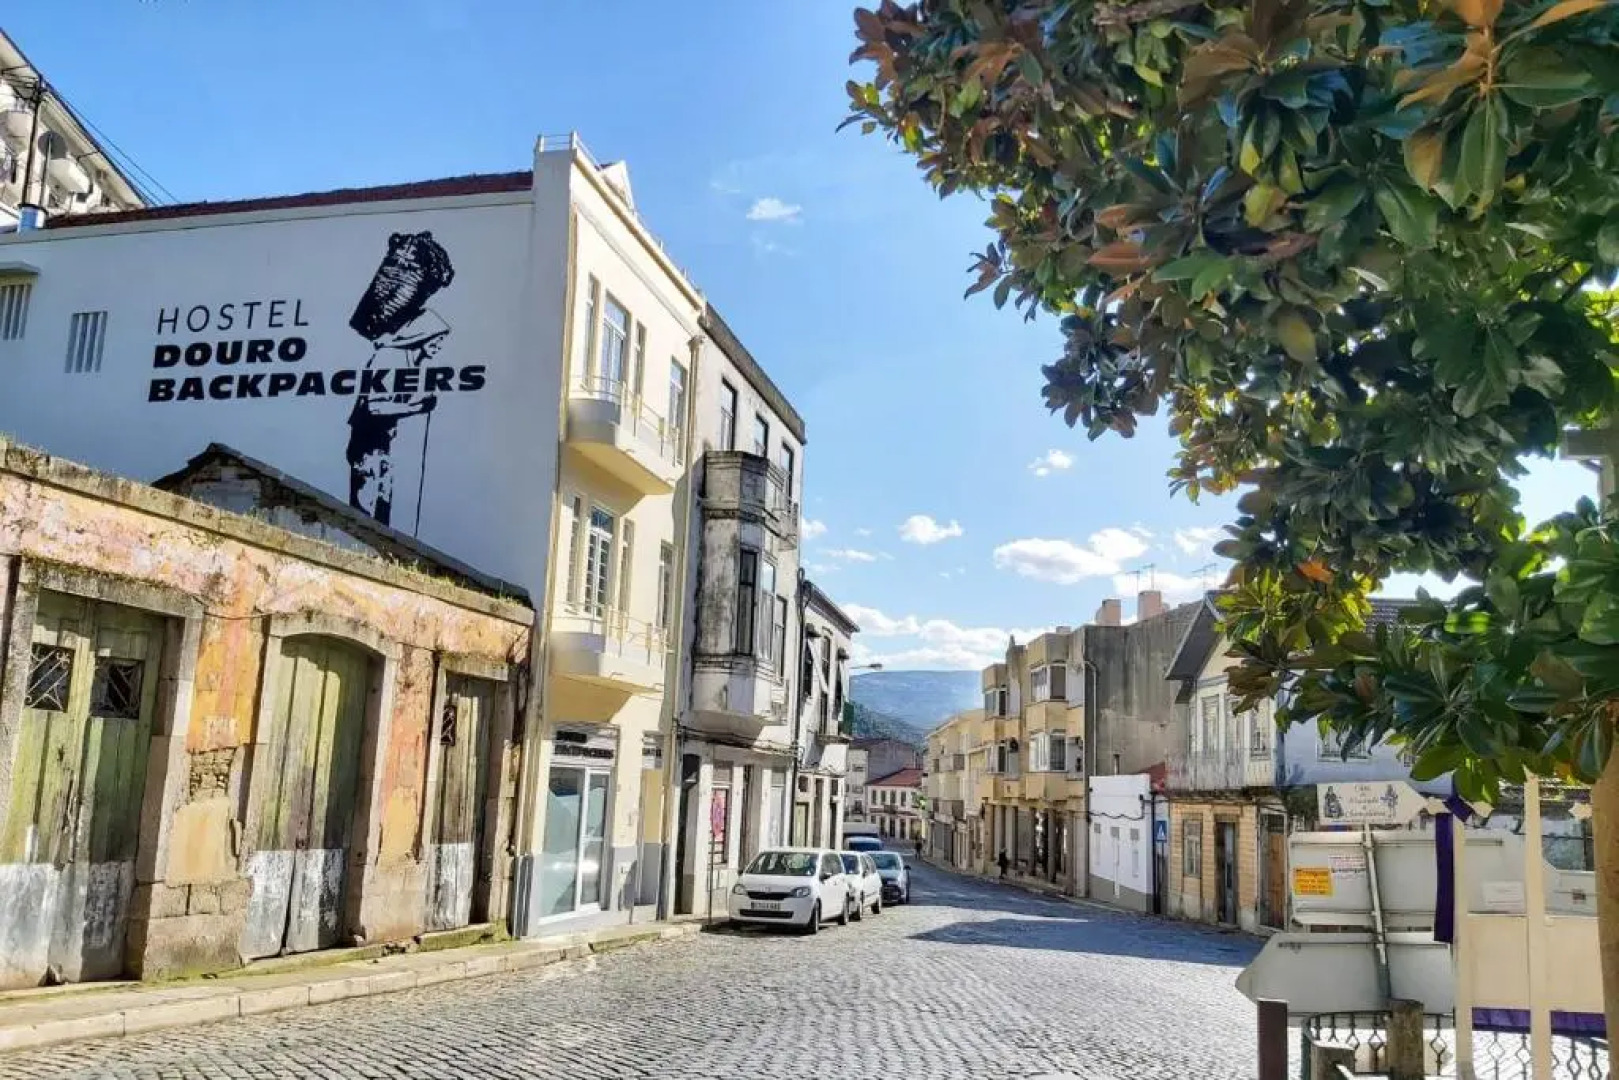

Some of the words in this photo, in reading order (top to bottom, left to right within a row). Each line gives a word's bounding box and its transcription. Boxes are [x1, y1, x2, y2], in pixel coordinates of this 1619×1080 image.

[157, 299, 309, 335] HOSTEL
[153, 337, 308, 369] DOURO
[148, 365, 486, 403] BACKPACKERS
